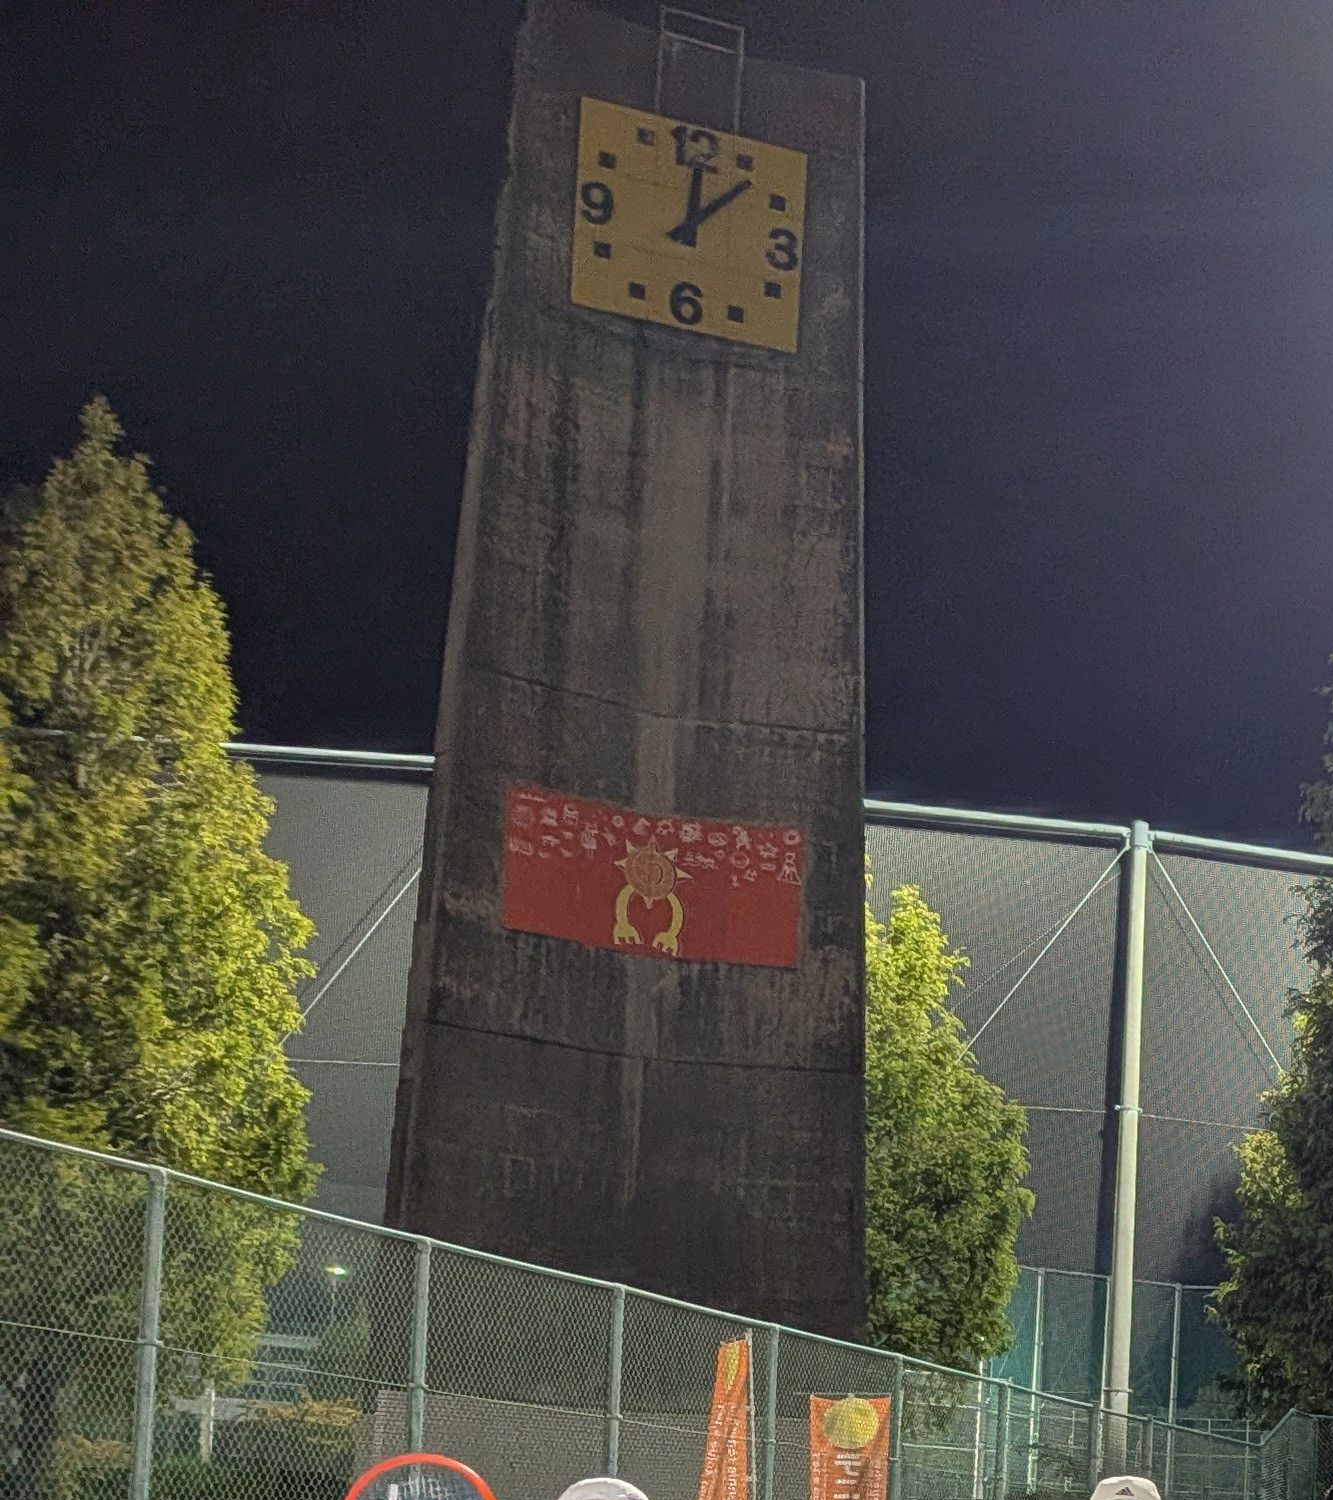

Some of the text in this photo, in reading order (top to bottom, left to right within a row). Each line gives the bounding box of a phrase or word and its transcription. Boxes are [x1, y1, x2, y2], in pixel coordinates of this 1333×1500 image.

[671, 125, 719, 174] 12
[581, 181, 614, 225] 9
[765, 228, 798, 271] 3
[669, 281, 703, 325] 6
